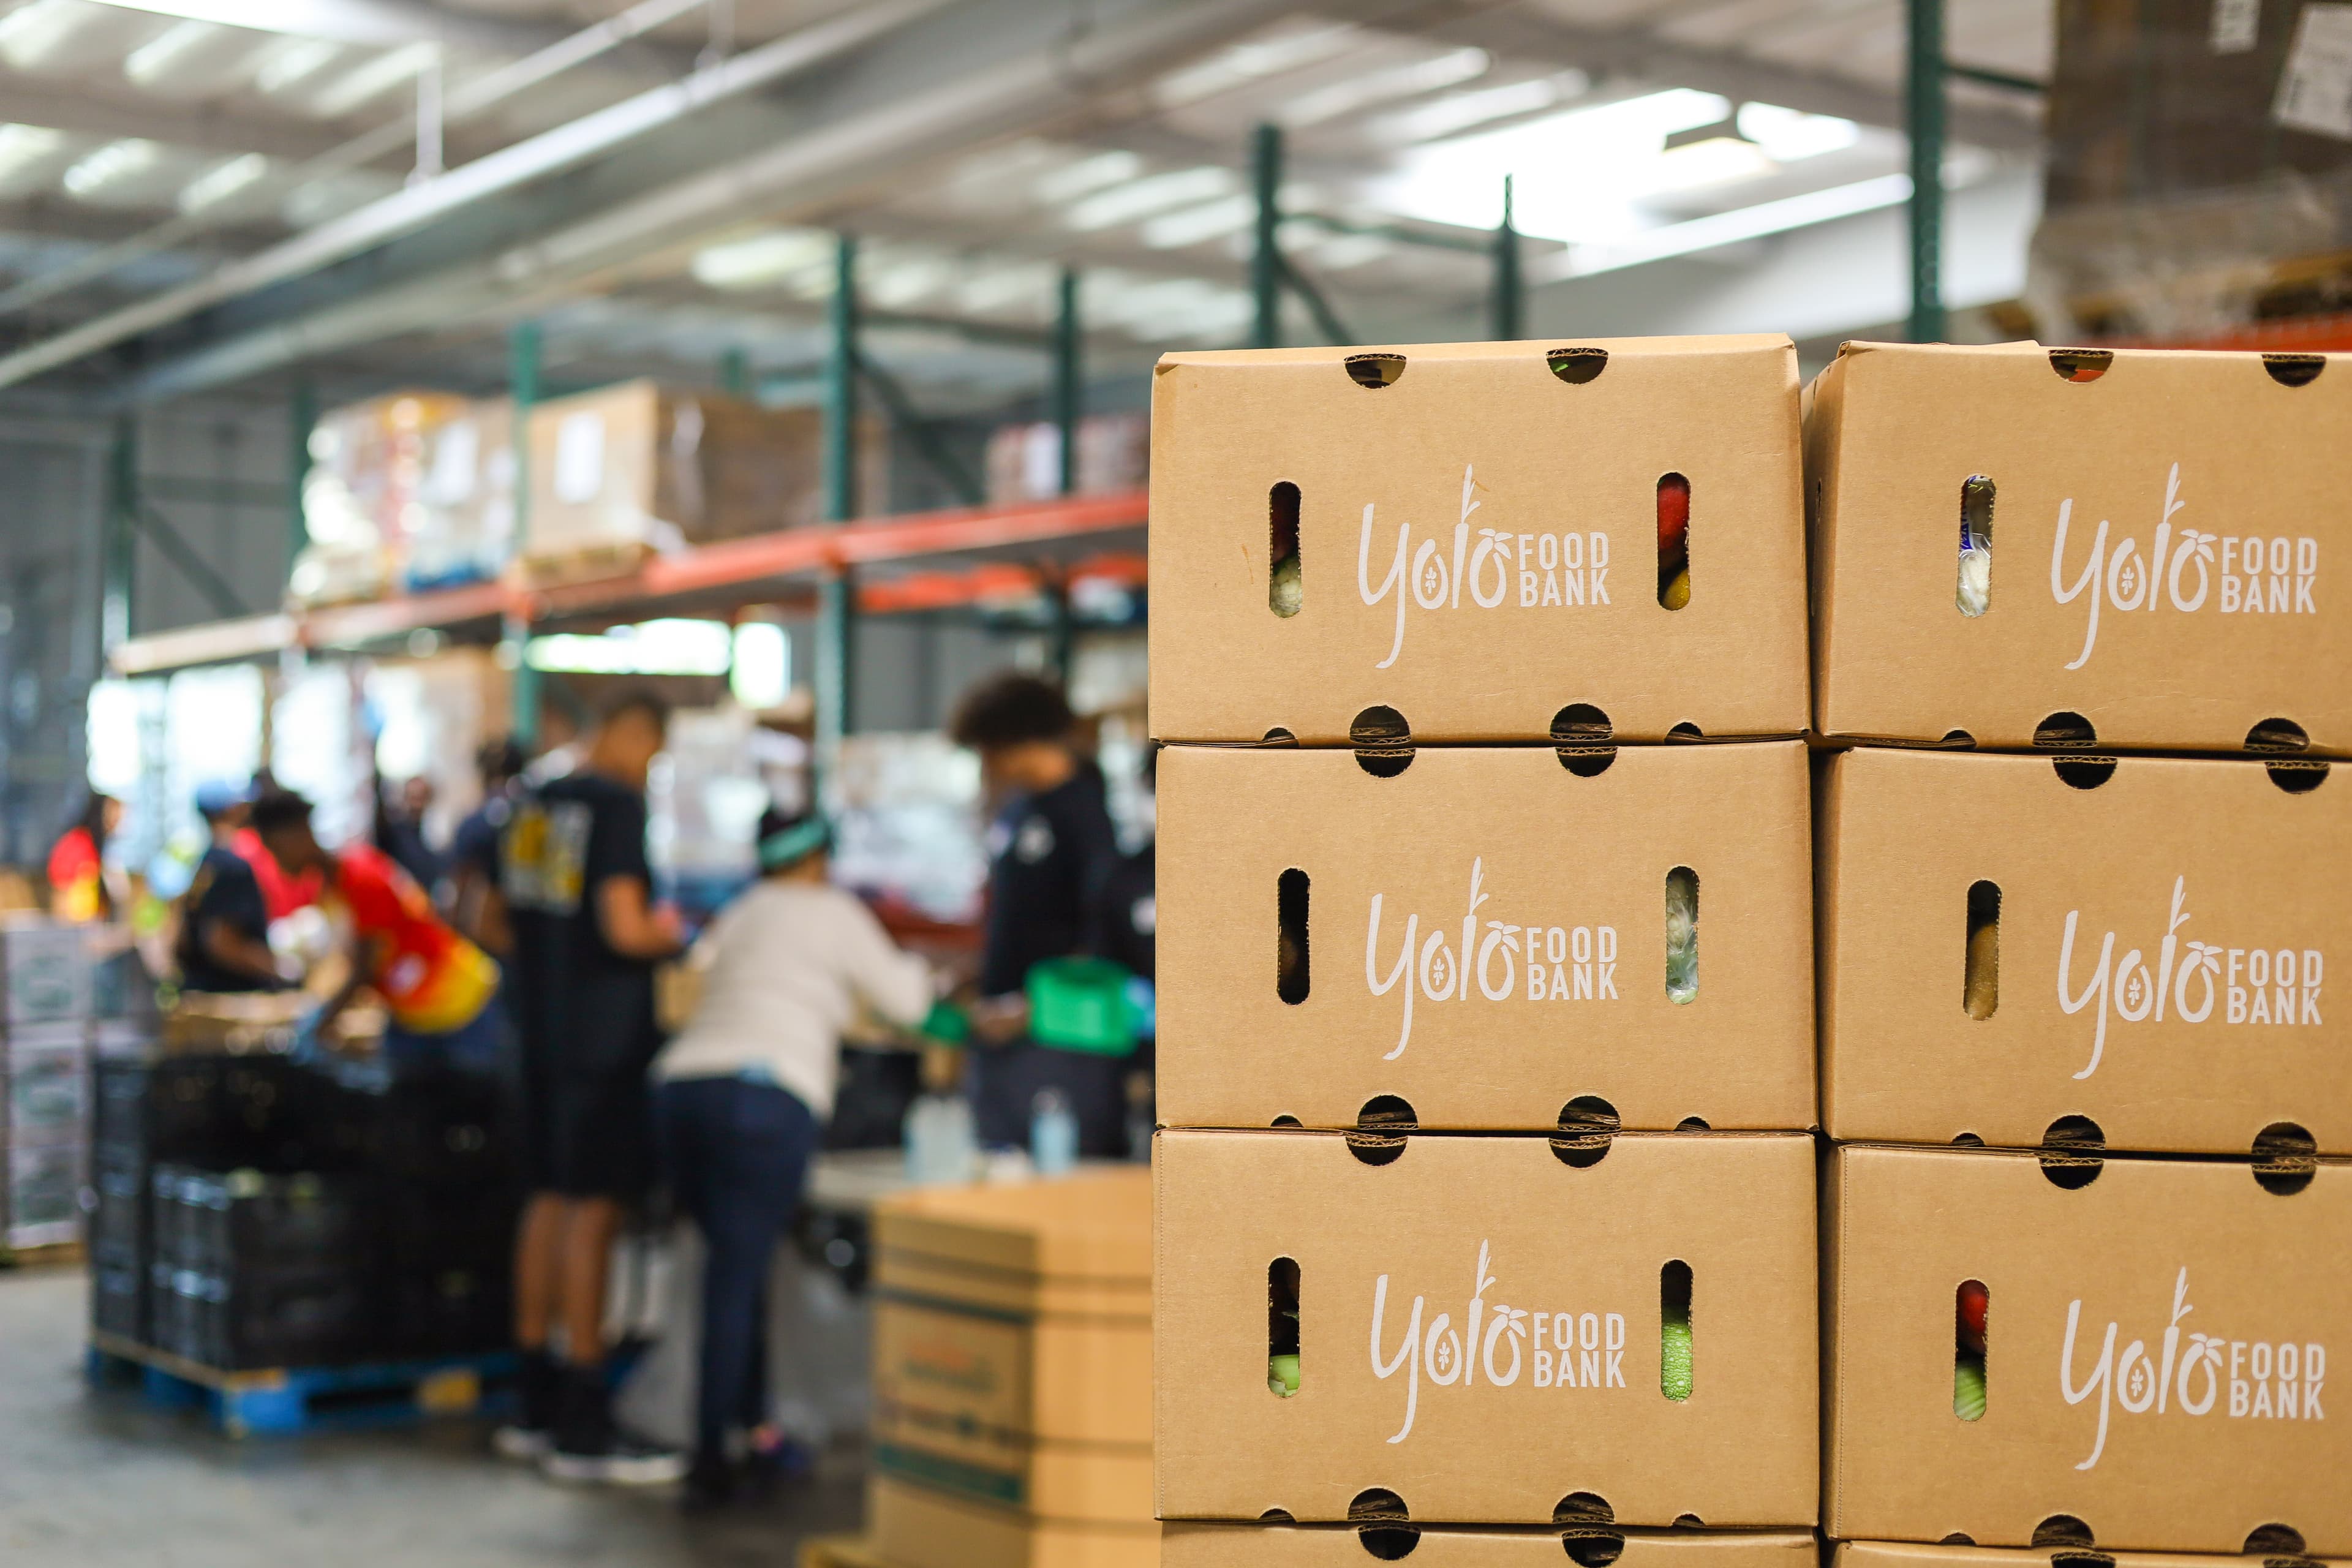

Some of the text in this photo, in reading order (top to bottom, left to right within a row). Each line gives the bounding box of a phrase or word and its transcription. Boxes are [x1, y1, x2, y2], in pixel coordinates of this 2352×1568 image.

[1518, 532, 1609, 570] FOOD
[2222, 537, 2318, 575] FOOD
[1519, 568, 1610, 606] BANK
[2221, 575, 2318, 614] BANK
[1526, 926, 1619, 964] FOOD
[1527, 962, 1619, 1001] BANK
[2228, 949, 2324, 987] FOOD
[2227, 986, 2323, 1025] BANK
[1533, 1312, 1626, 1351] FOOD
[1534, 1349, 1627, 1387] BANK
[2231, 1341, 2325, 1381] FOOD
[2230, 1379, 2325, 1419] BANK
